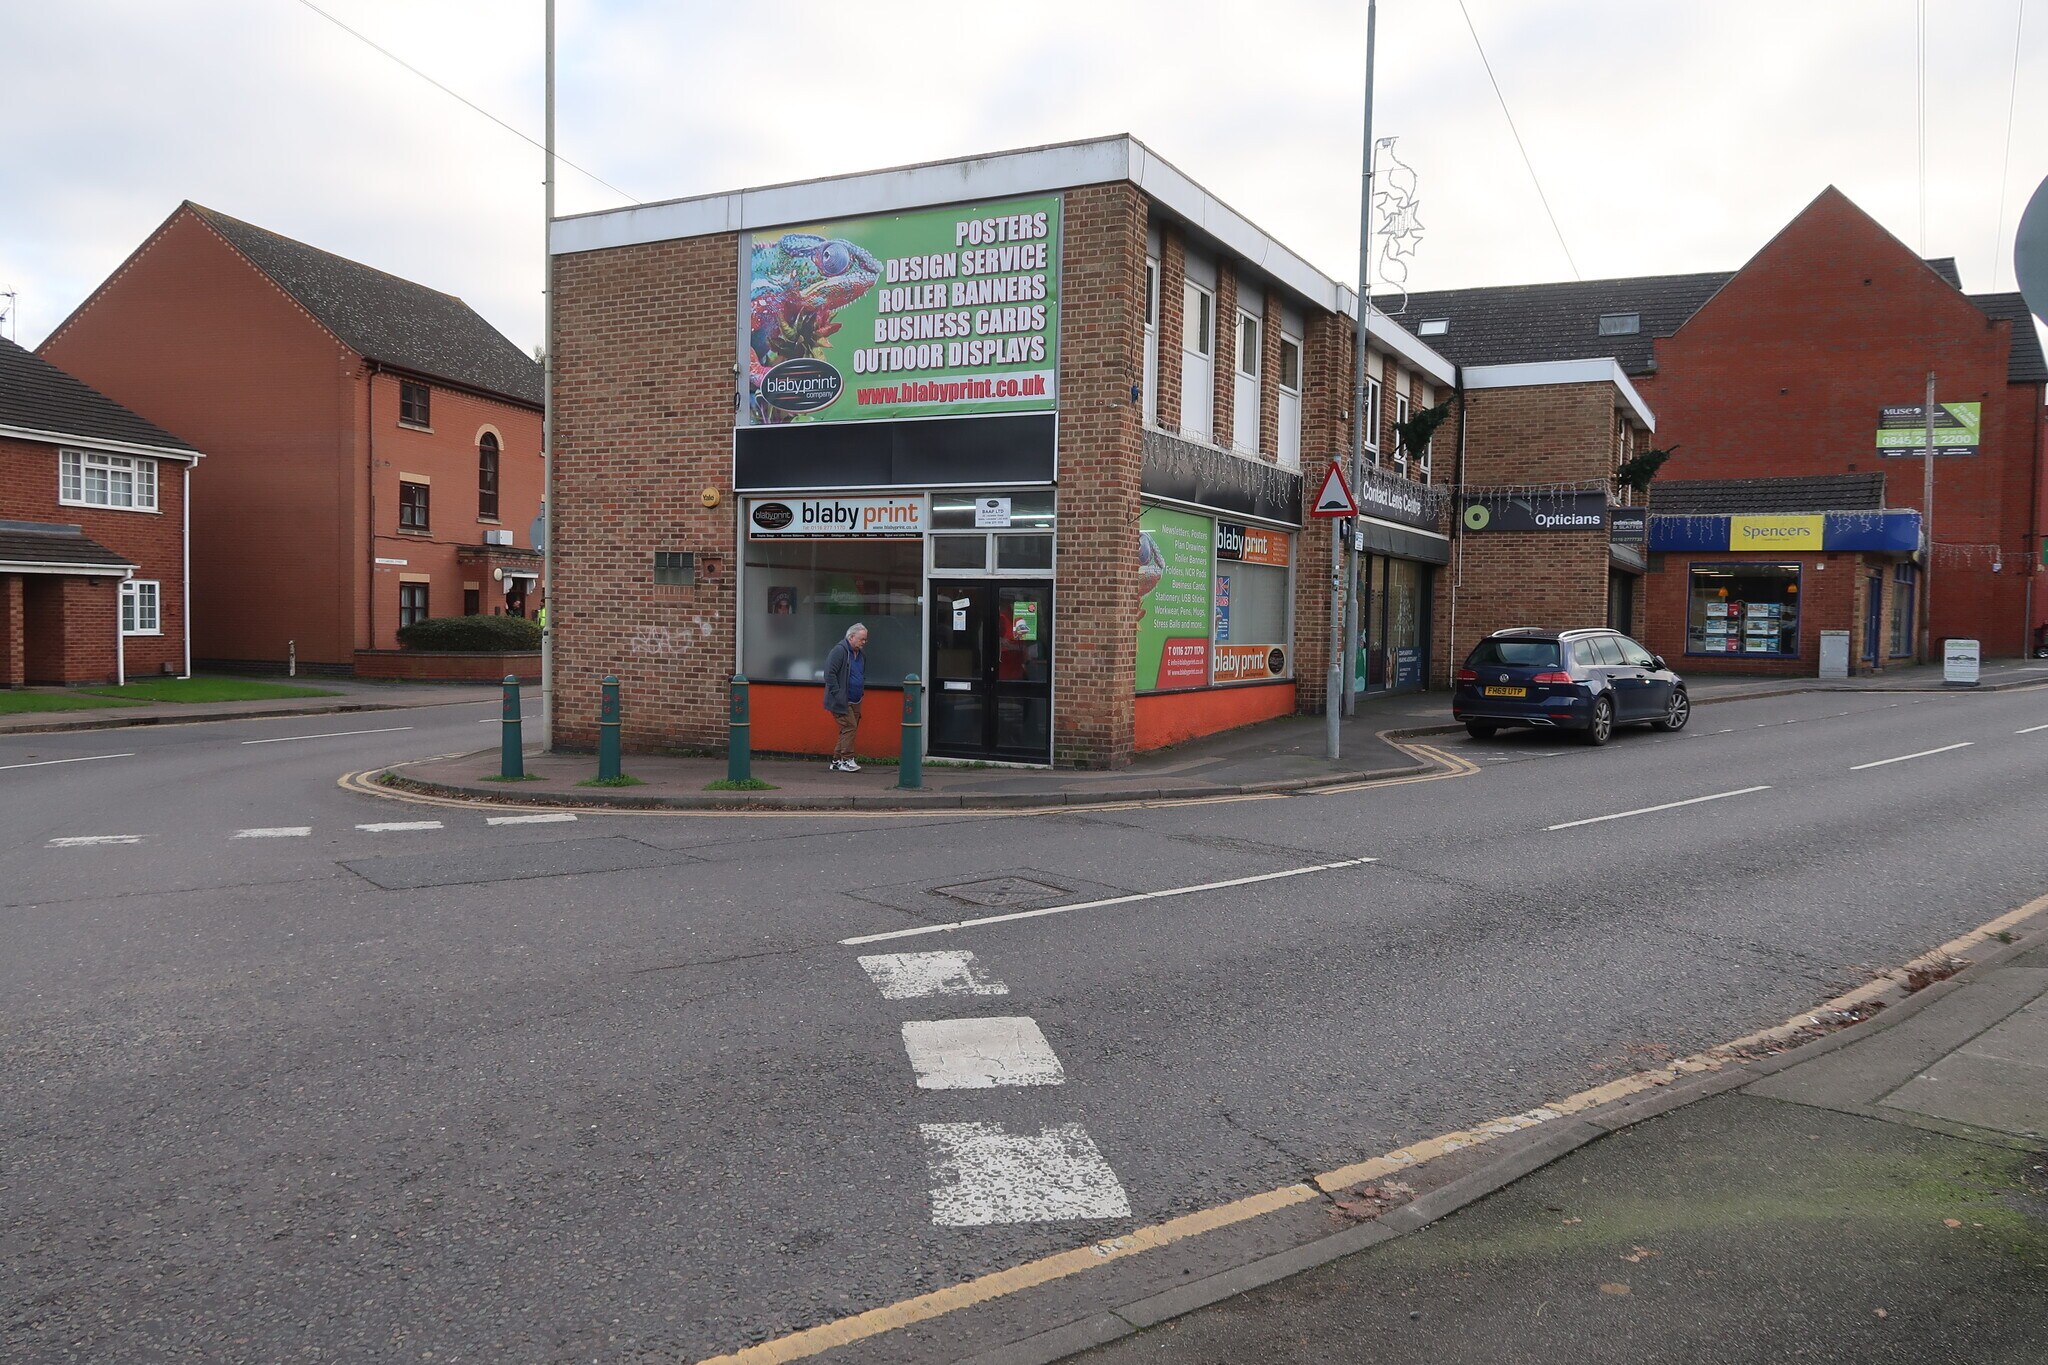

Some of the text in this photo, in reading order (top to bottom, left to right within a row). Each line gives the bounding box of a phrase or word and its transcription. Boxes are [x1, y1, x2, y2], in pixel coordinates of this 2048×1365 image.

[956, 212, 1047, 246] POSTERS
[886, 243, 1047, 283] DESIGN SERVICE
[878, 274, 1046, 313] ROLLER BANNERS
[874, 304, 1046, 343] BUSINESS CARDS
[853, 335, 1045, 374] OUTDOOR DISPLAYS
[806, 391, 834, 399] company
[857, 374, 1045, 405] www.blabyprint.co.uk
[1882, 436, 1911, 446] 0845
[1941, 435, 1971, 444] 2200
[1363, 481, 1388, 505] Contact
[802, 500, 919, 530] blaby print
[1535, 513, 1601, 528] Opticians
[1191, 529, 1208, 540] Posters
[1743, 525, 1811, 539] Spencers
[1174, 540, 1186, 550] Plan
[1217, 525, 1244, 558] blaby
[1245, 531, 1268, 560] print
[1175, 553, 1206, 566] Roller Banners
[1196, 568, 1206, 579] Pads
[1172, 579, 1192, 589] Business
[1182, 593, 1191, 603] USB
[1154, 619, 1168, 628] Stress
[1169, 619, 1180, 628] Balls
[1181, 620, 1190, 628] and
[1172, 646, 1183, 656] 0116
[1184, 646, 1193, 656] 277
[1213, 648, 1264, 677] blaby print
[1508, 688, 1523, 696] UTP
